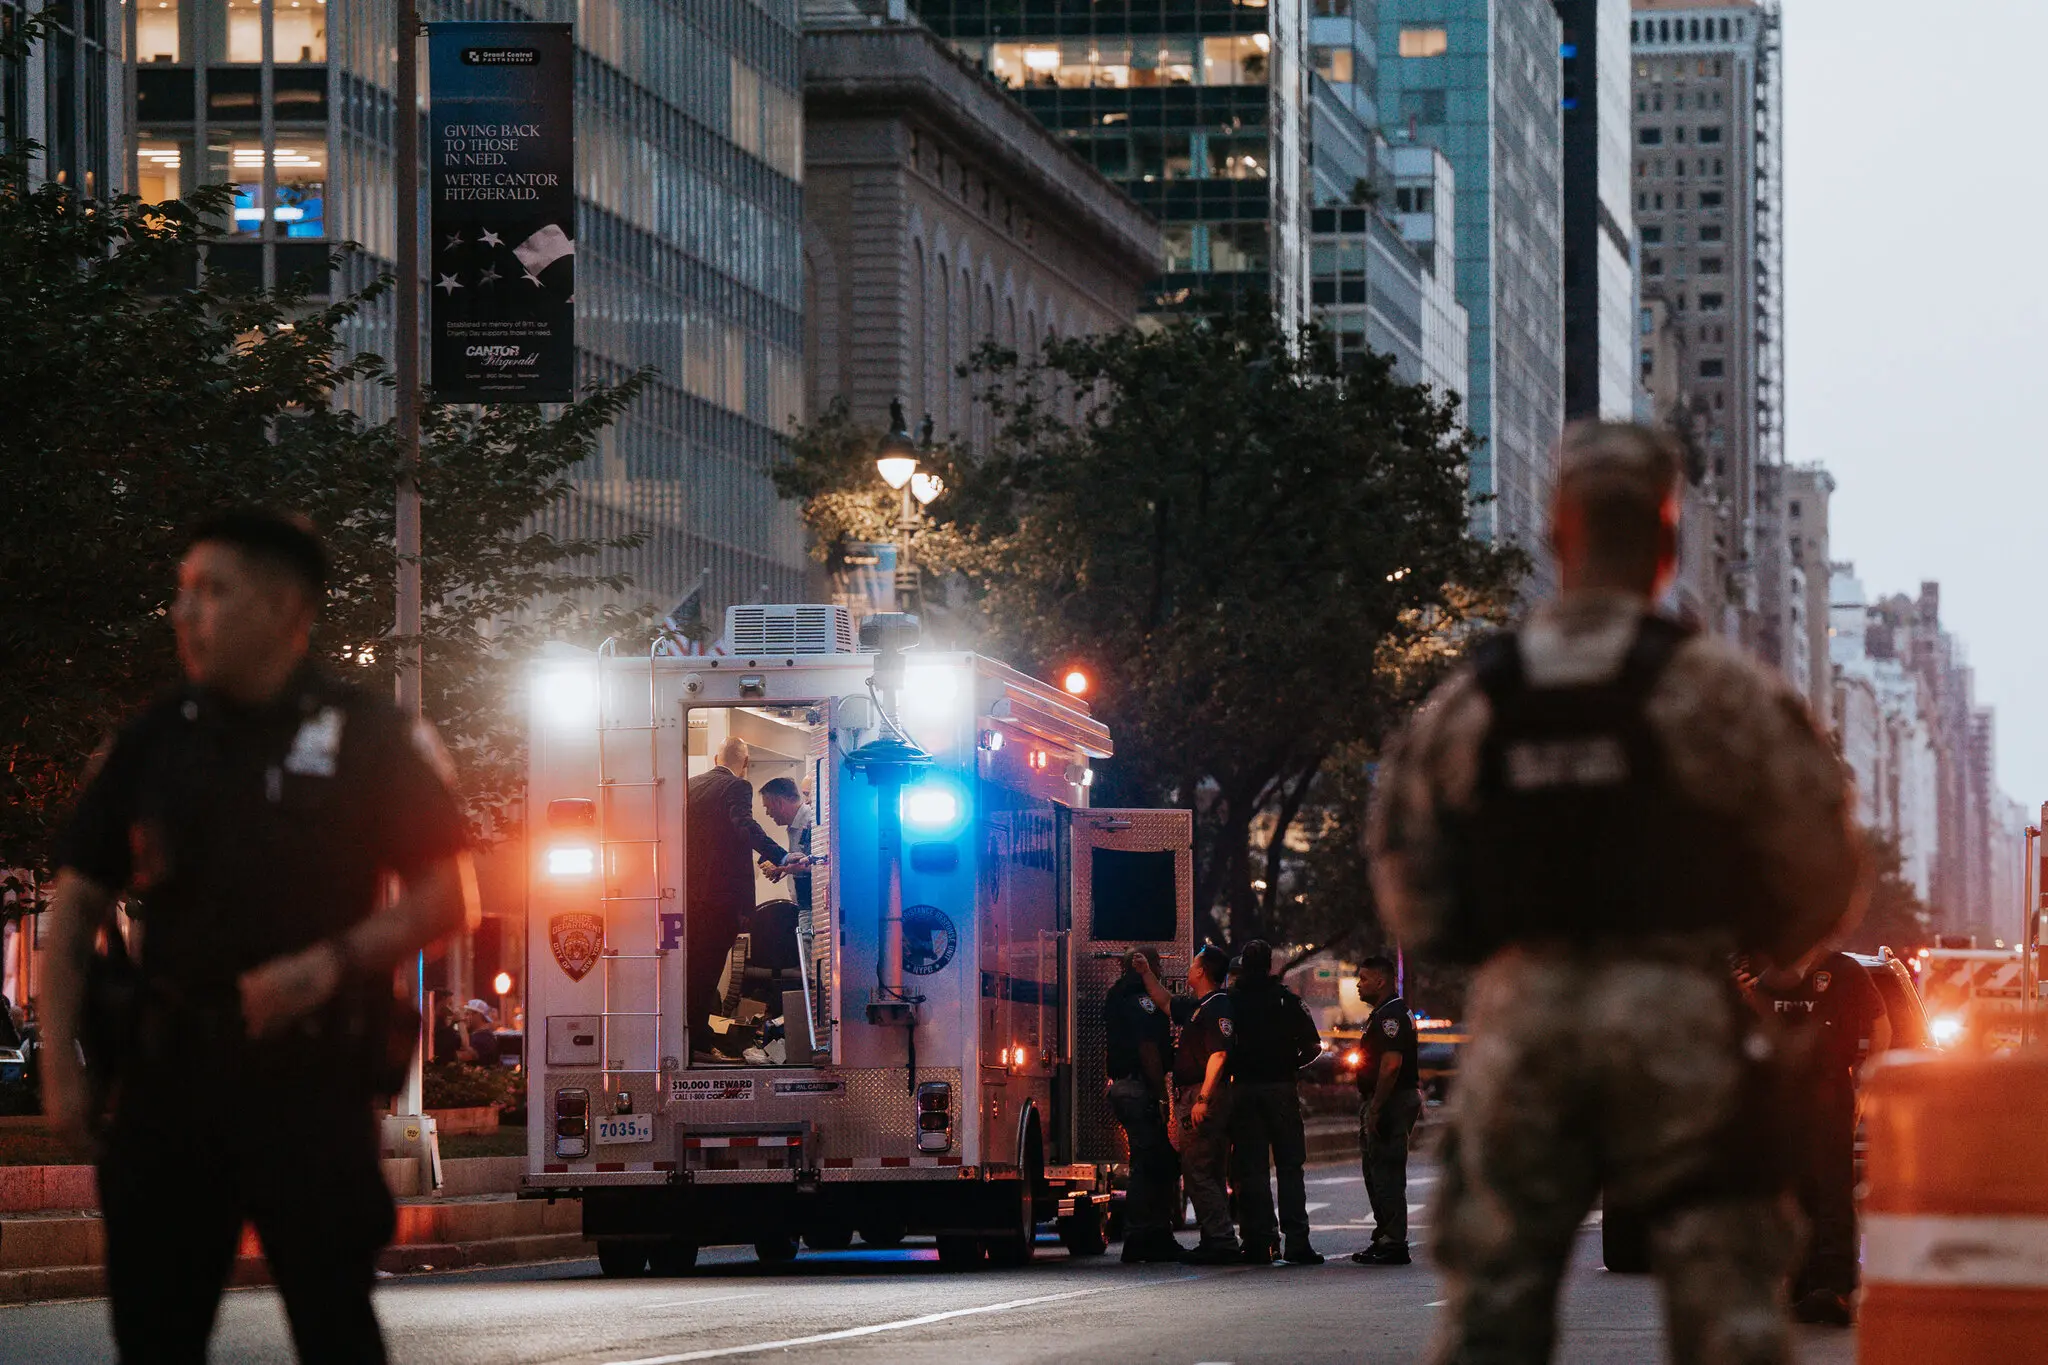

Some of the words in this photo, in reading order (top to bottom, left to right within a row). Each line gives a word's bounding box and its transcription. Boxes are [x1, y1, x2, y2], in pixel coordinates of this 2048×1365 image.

[444, 125, 497, 137] GIVING
[501, 125, 540, 137] BACK
[444, 139, 466, 151] TO
[469, 139, 519, 151] THOSE
[445, 153, 460, 165] IN
[465, 153, 507, 165] NEED.
[495, 173, 558, 186] CANTOR
[445, 188, 540, 200] FITZGERALD.
[466, 346, 520, 356] CANTOR
[481, 353, 539, 370] Fitzgerald
[553, 922, 601, 934] DEPARTMENT
[554, 943, 563, 958] CITY
[563, 961, 571, 969] OF
[581, 958, 593, 973] NEW
[592, 938, 601, 956] YORK
[945, 945, 954, 960] UNIT
[913, 966, 933, 974] NYPD
[1774, 1000, 1814, 1012] FDY
[673, 1081, 710, 1090] $10,000
[713, 1080, 752, 1088] REWARD
[600, 1122, 636, 1137] 7035
